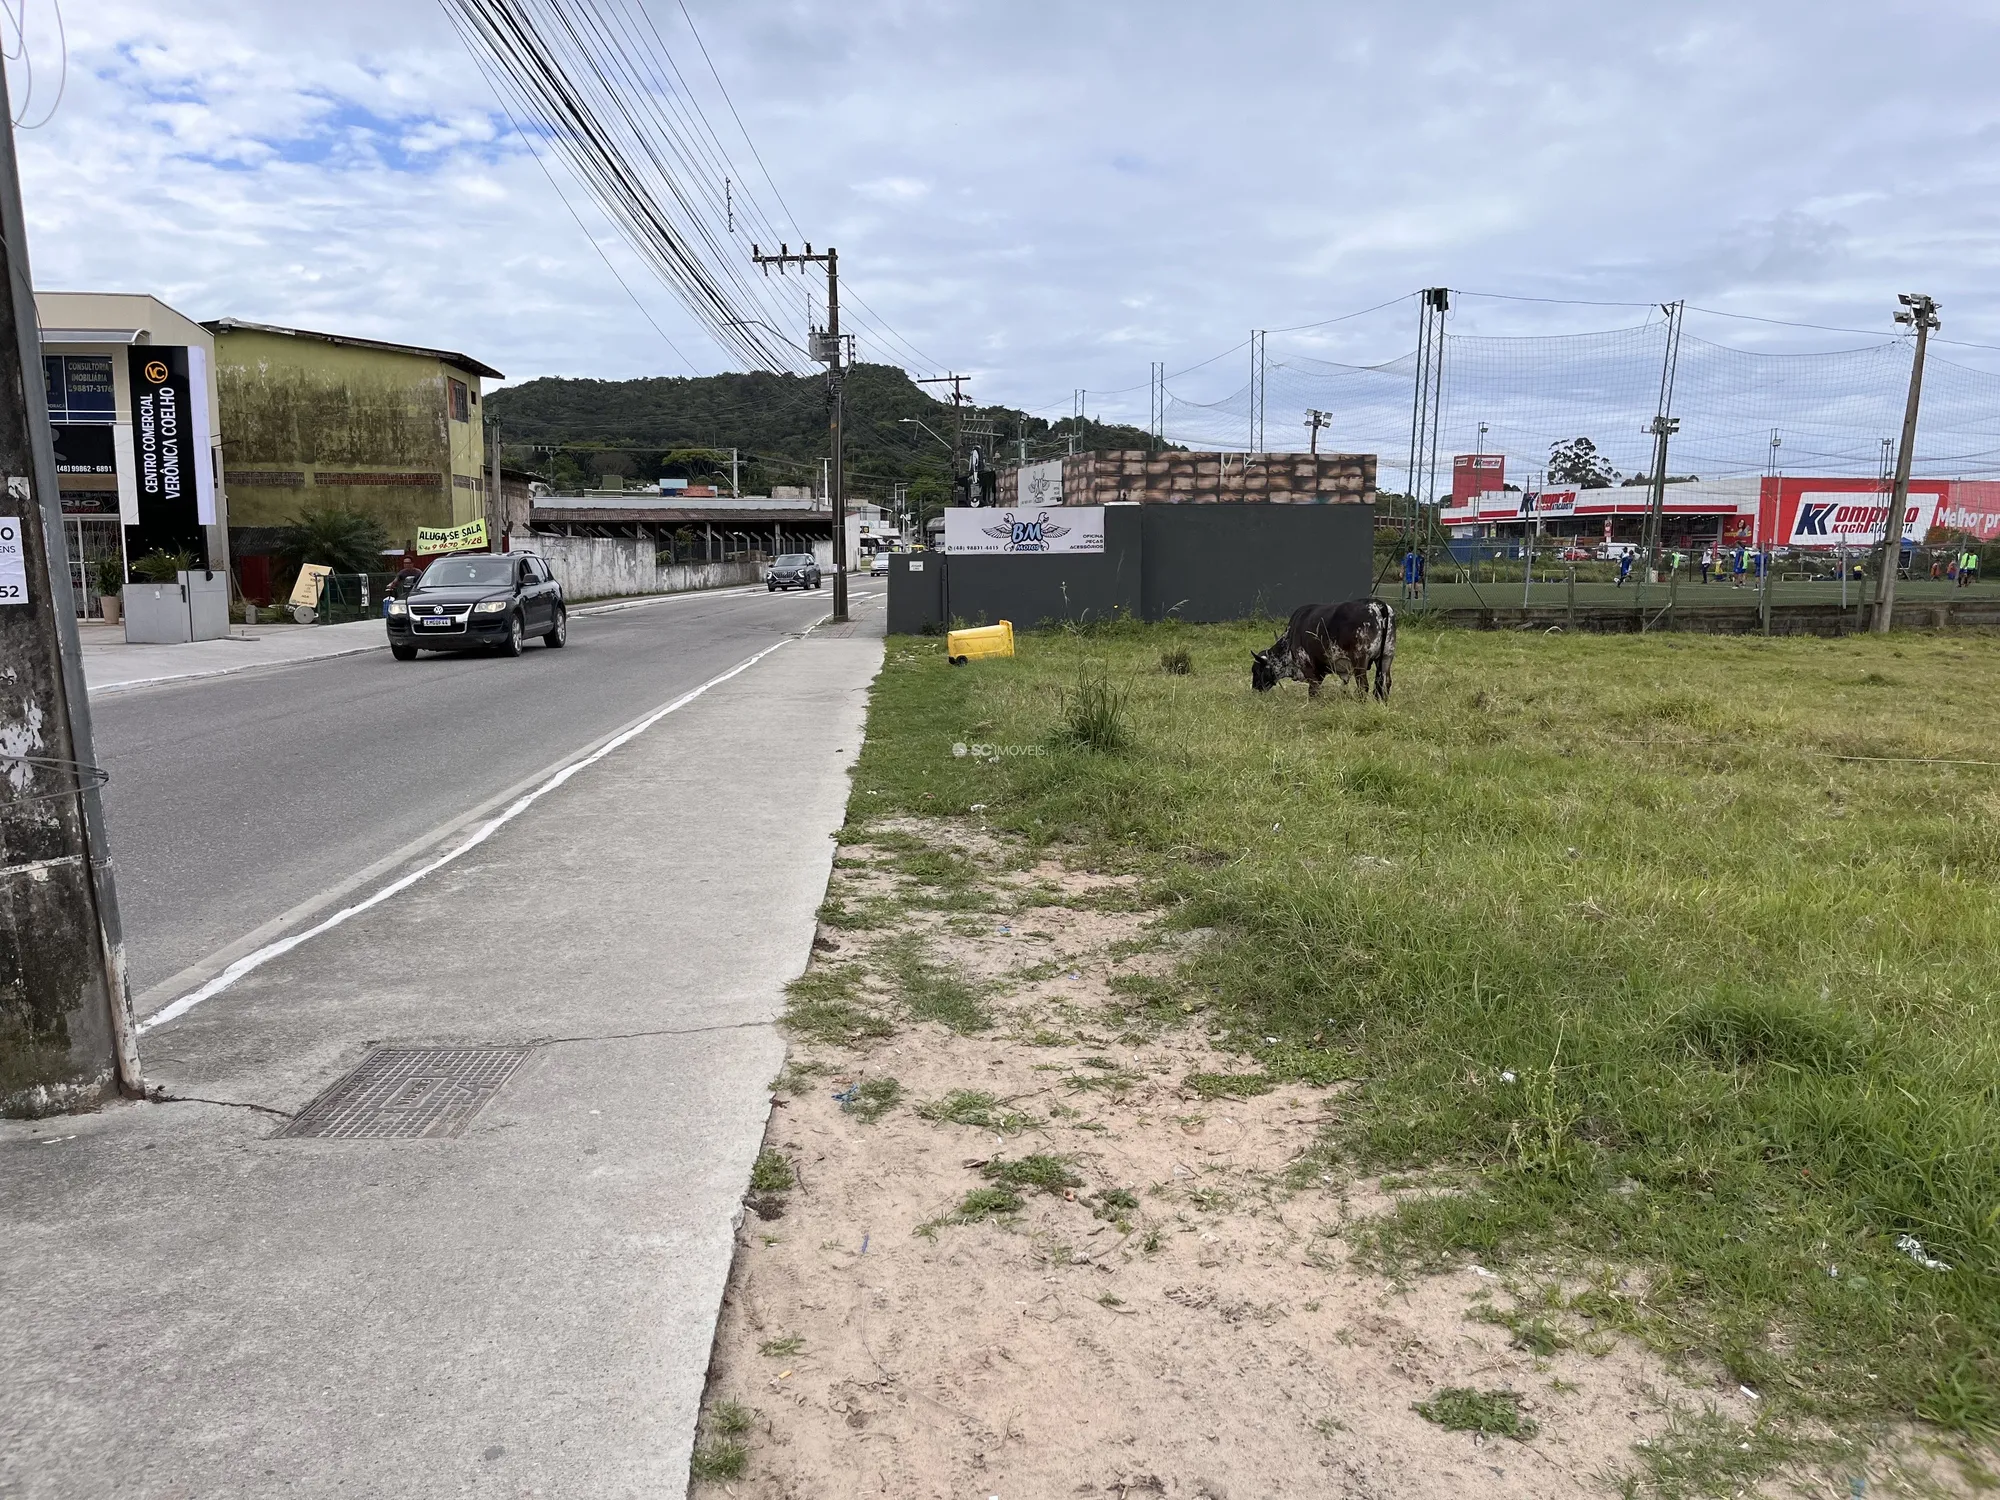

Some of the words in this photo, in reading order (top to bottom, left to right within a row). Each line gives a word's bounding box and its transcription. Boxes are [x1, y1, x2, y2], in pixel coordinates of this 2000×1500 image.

[71, 371, 108, 382] IMOBILIÁRIA
[140, 393, 156, 452] COMERCIAL
[159, 387, 177, 436] COELHO
[56, 464, 71, 473] (48)
[71, 464, 92, 473] 99862
[96, 465, 112, 473] 6891
[145, 453, 159, 493] CENTRO
[160, 438, 180, 500] VERÔNICA
[419, 531, 460, 542] ALUGA-SE
[461, 523, 482, 537] SALA
[1936, 507, 1984, 528] Melhor
[1984, 513, 2000, 534] pr
[1011, 522, 1043, 544] BM
[1015, 543, 1041, 551] MOTOS
